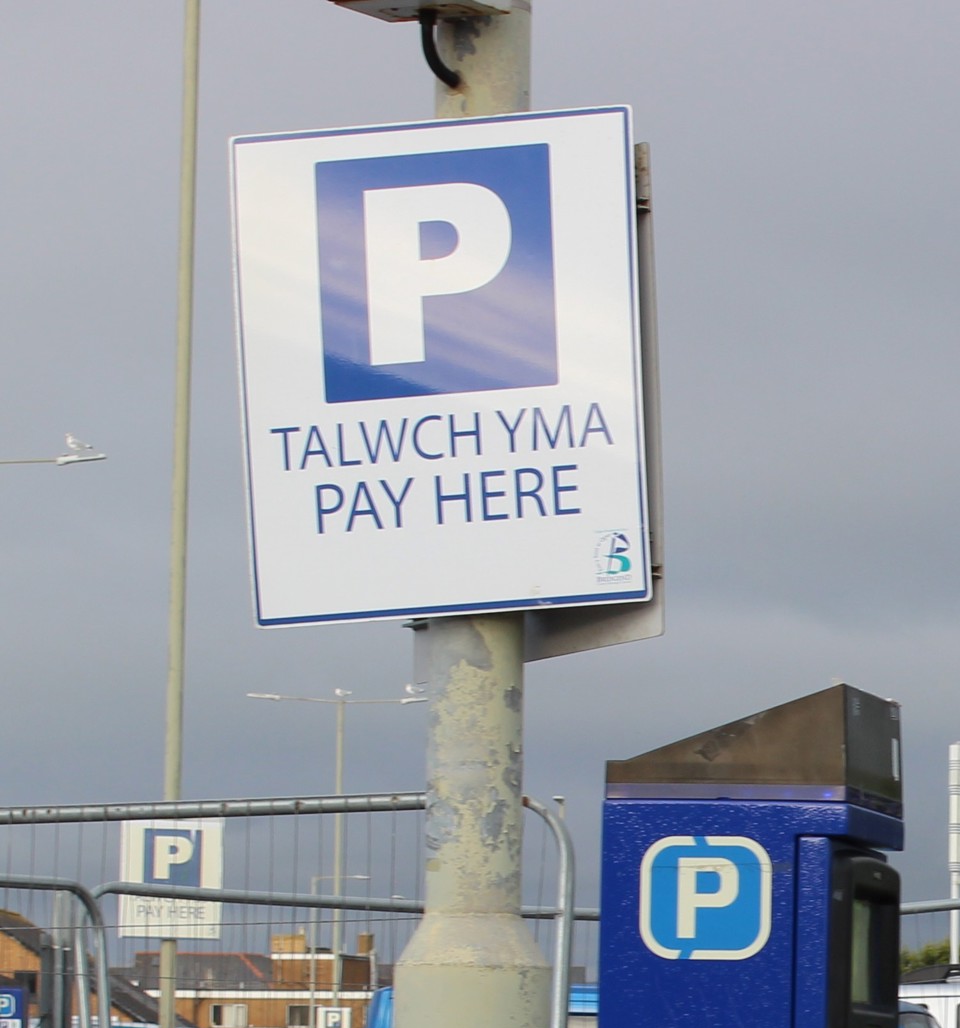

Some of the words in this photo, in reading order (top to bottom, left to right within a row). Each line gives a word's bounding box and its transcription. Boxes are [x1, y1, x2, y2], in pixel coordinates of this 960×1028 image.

[363, 182, 512, 366] P
[270, 412, 482, 472] TALWCH
[495, 402, 615, 455] YMA
[314, 477, 415, 535] PAY
[435, 464, 582, 525] HERE
[153, 835, 194, 880] P
[136, 905, 164, 918] PAY
[674, 857, 740, 939] P
